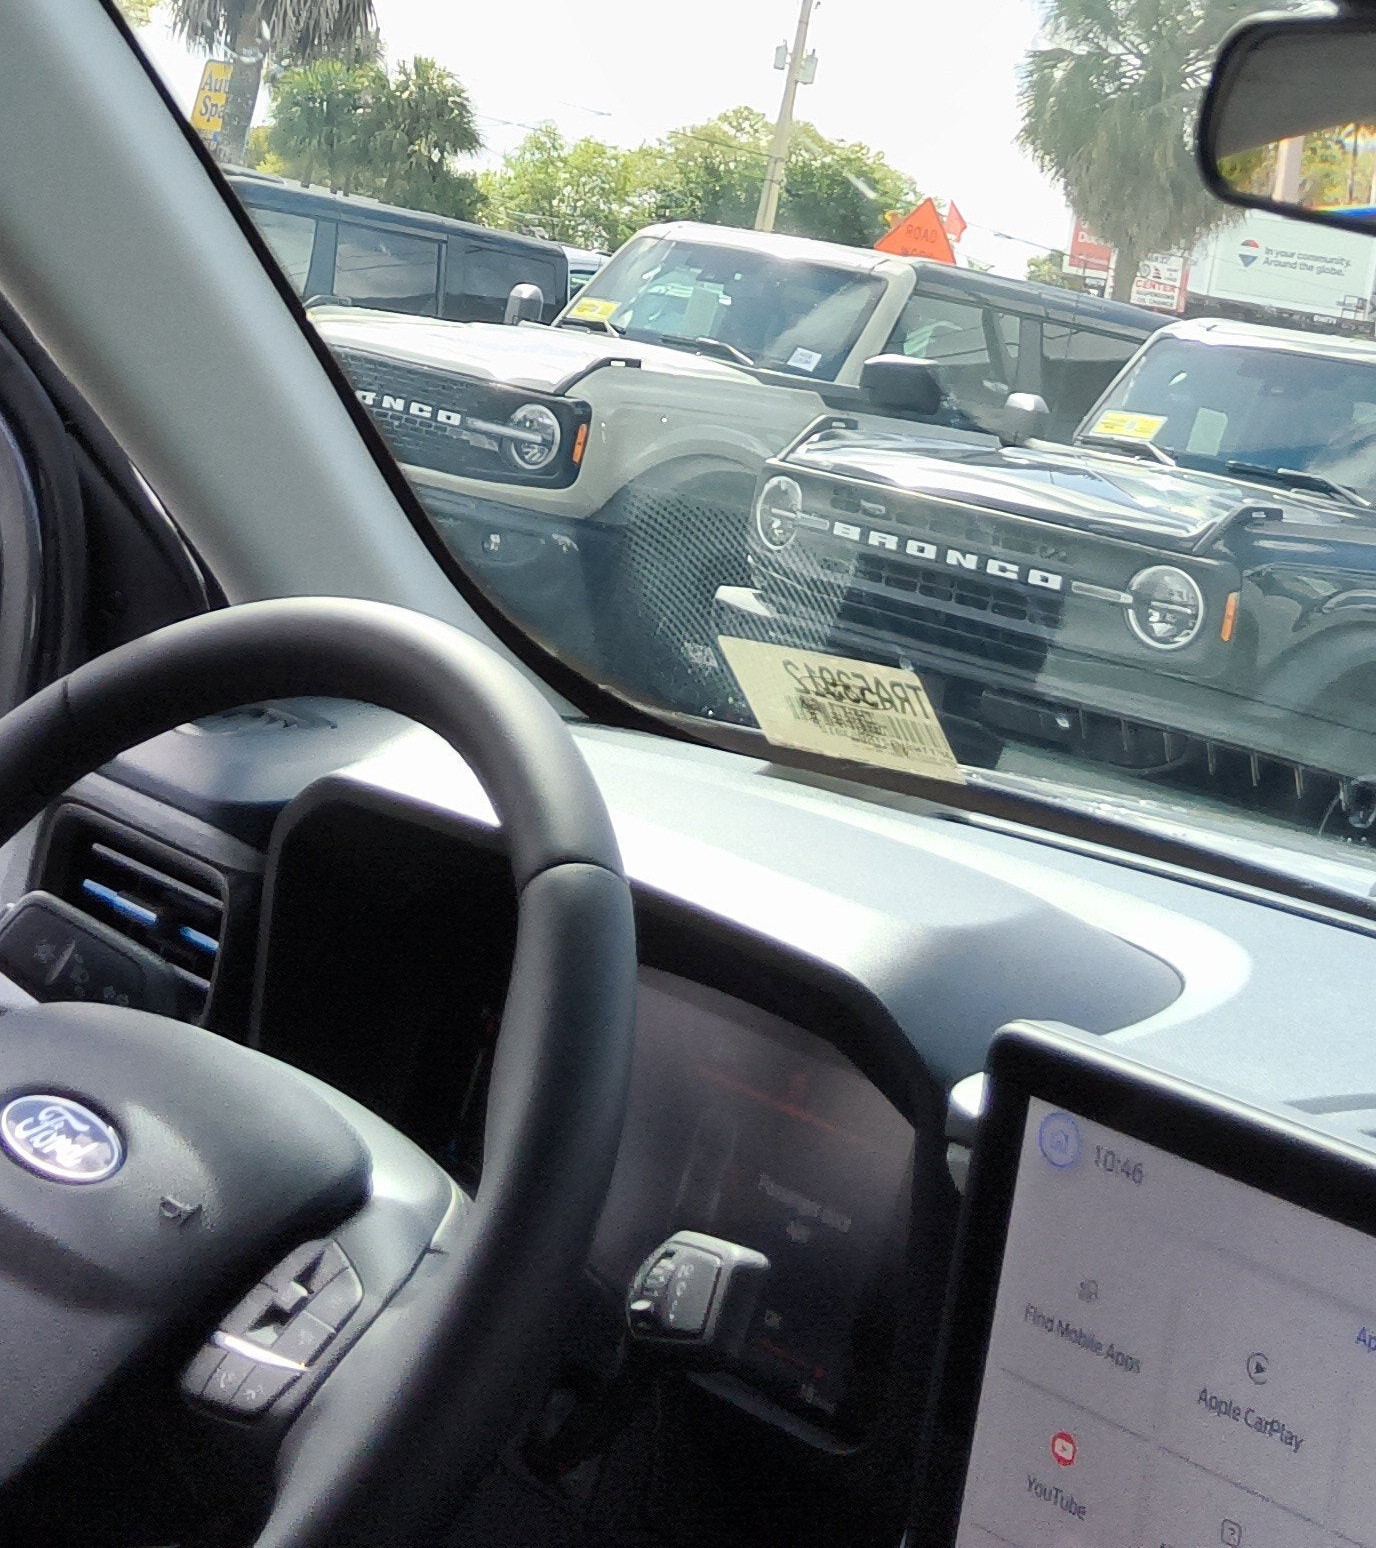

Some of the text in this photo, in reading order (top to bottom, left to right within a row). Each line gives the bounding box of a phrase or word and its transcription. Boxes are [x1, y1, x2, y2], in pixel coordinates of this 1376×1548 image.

[907, 223, 938, 244] ROAD
[1263, 257, 1345, 277] Around the globe.
[1274, 248, 1296, 259] your
[1297, 251, 1352, 269] community.
[355, 390, 462, 426] ONCO
[832, 521, 1063, 591] BRONCO
[1094, 1145, 1145, 1186] 10:46
[1024, 1303, 1141, 1374] Find Mobile Apps
[1197, 1387, 1304, 1453] Apple CarPlay
[1026, 1474, 1087, 1522] YouTube
